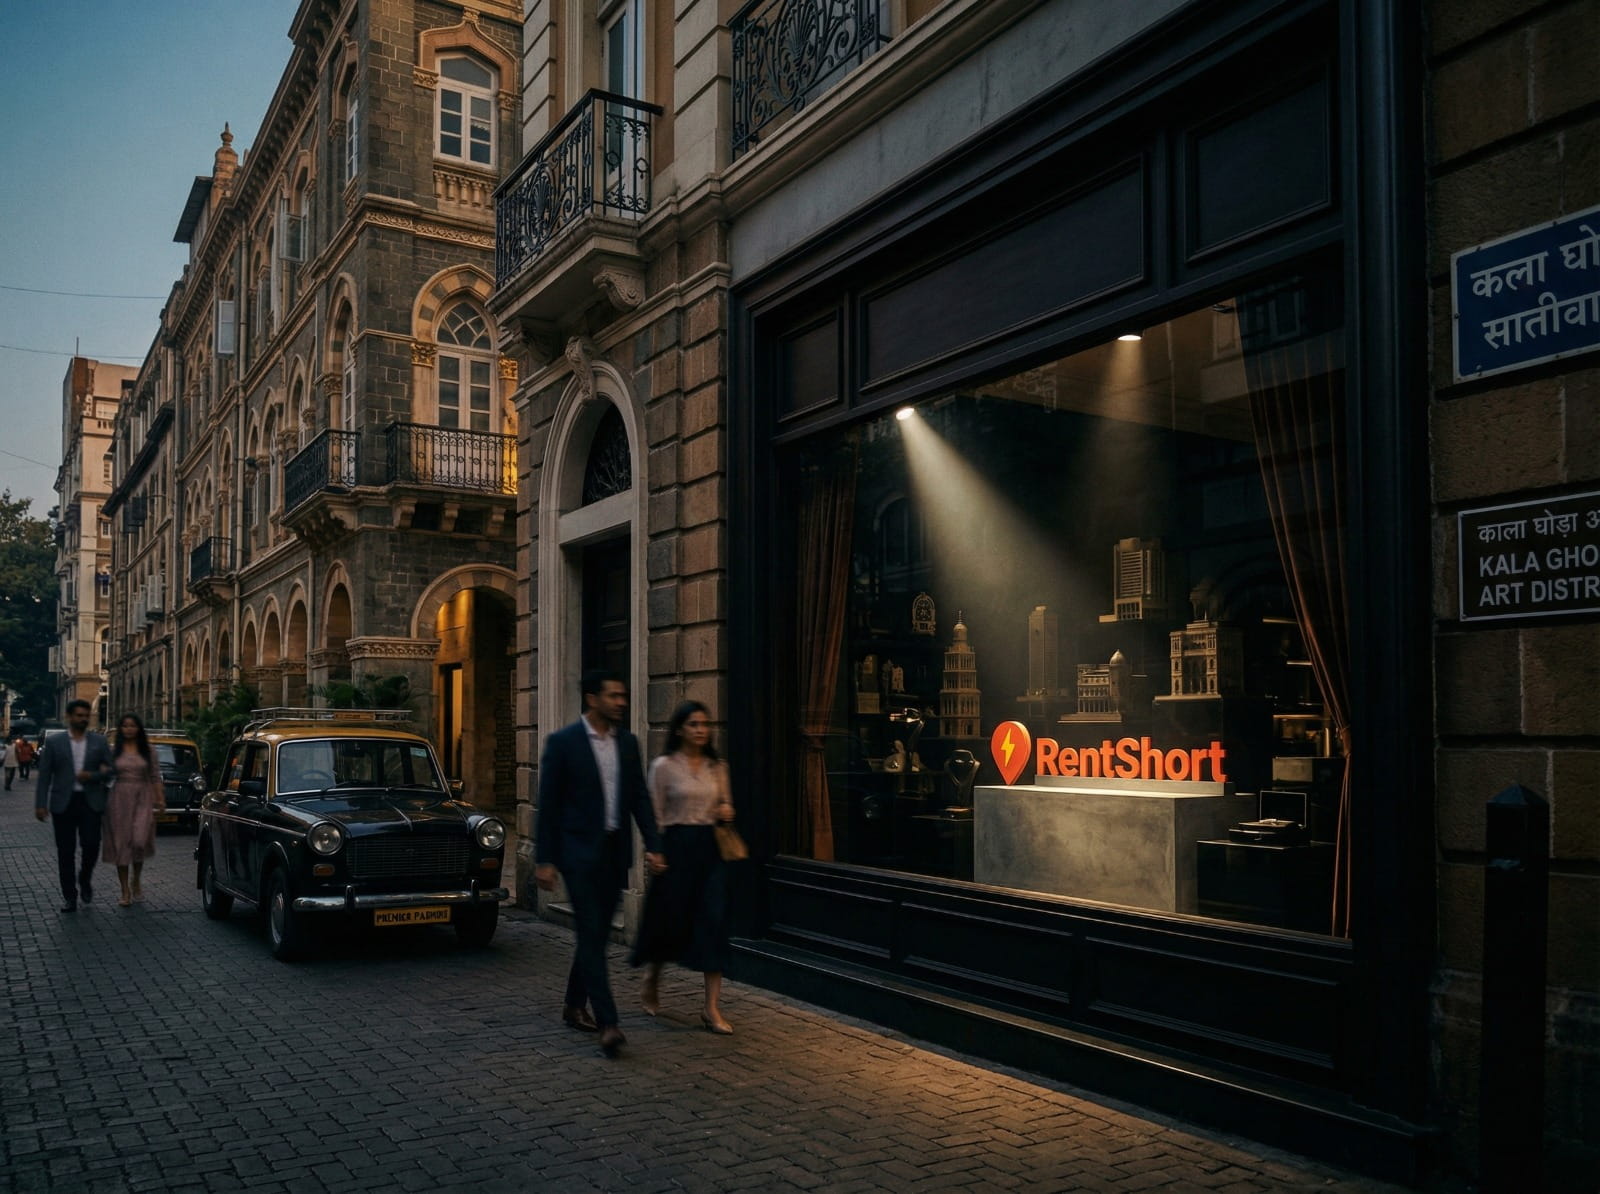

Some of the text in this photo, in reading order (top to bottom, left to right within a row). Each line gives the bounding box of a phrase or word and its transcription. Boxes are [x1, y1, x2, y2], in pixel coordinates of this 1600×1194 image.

[1470, 251, 1549, 298] कला
[1477, 520, 1528, 543] काला
[1532, 509, 1579, 538] घोड़ा
[1479, 544, 1599, 577] KALA GHO
[1479, 575, 1600, 607] ART DISTR
[1036, 736, 1228, 783] RentShort
